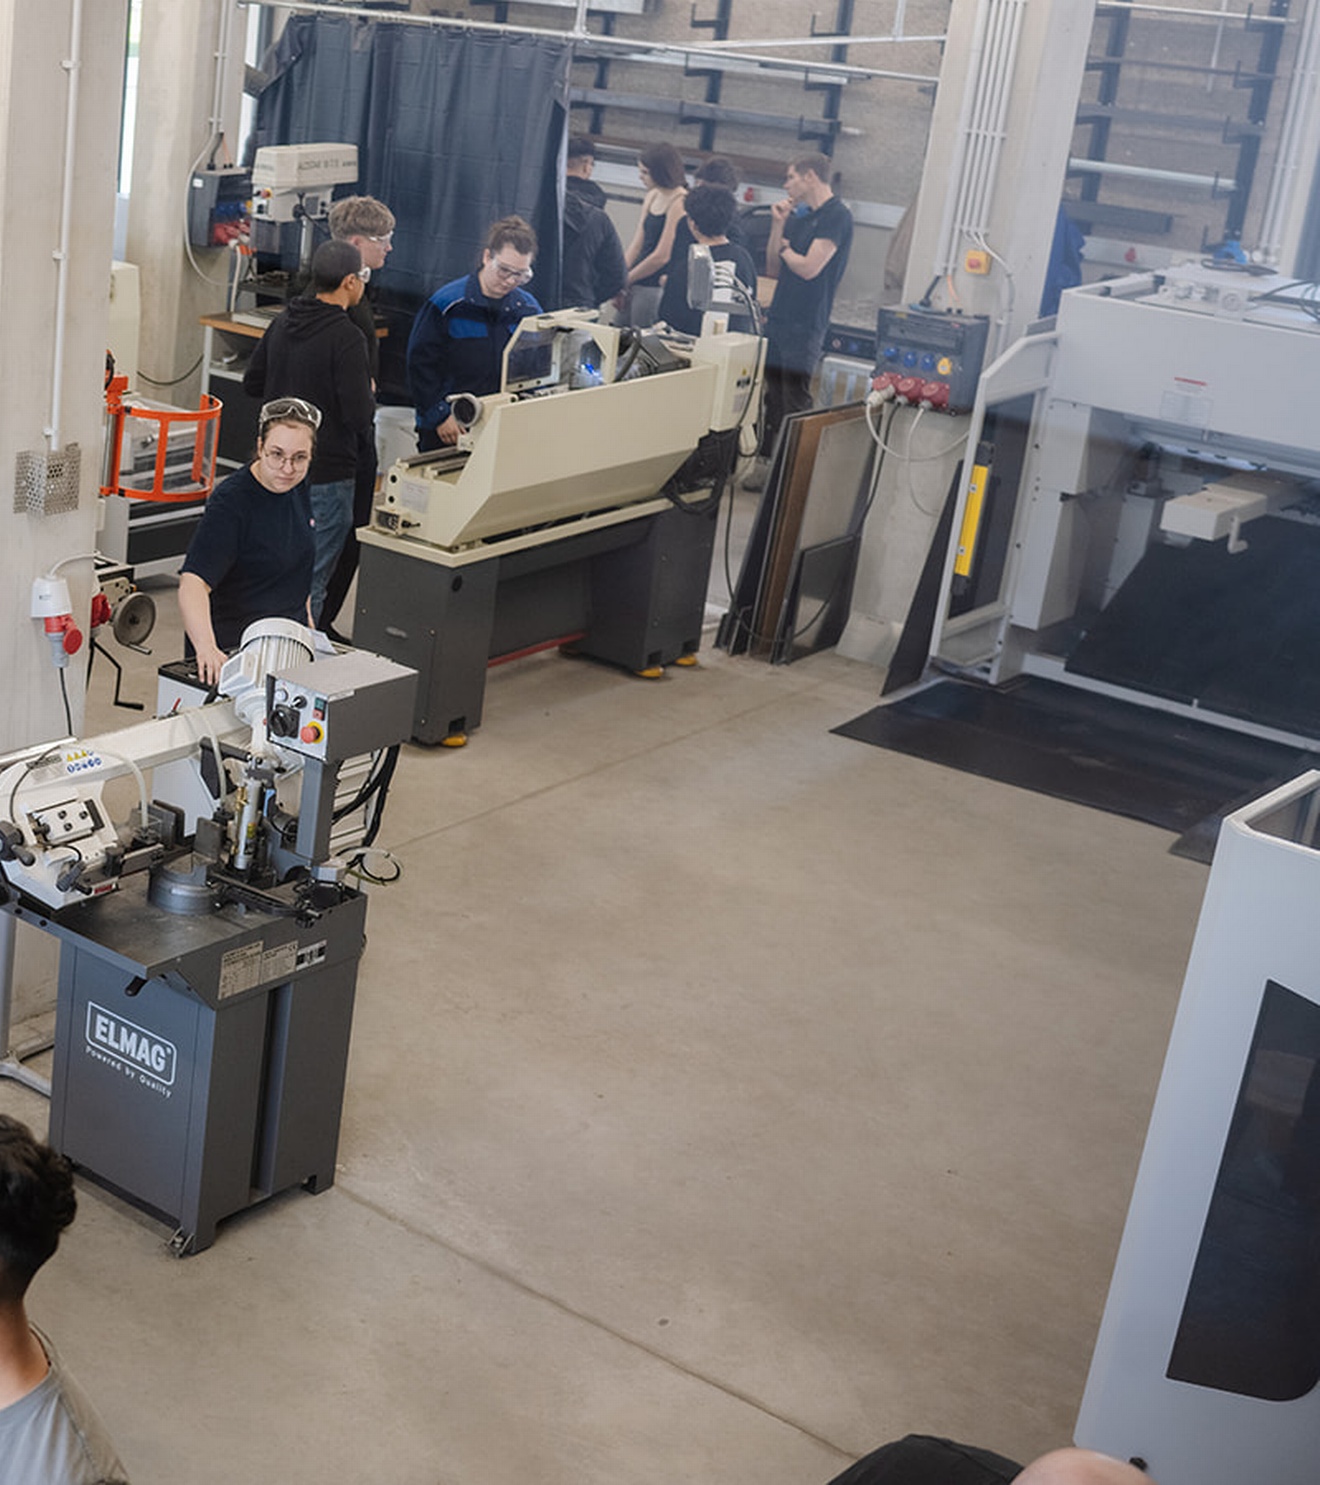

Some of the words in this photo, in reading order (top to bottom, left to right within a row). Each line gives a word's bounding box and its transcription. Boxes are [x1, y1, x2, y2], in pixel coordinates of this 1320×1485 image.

[95, 1013, 166, 1072] ELMAG
[86, 1045, 121, 1071] Powered
[125, 1066, 135, 1079] by
[140, 1074, 172, 1099] Quality
